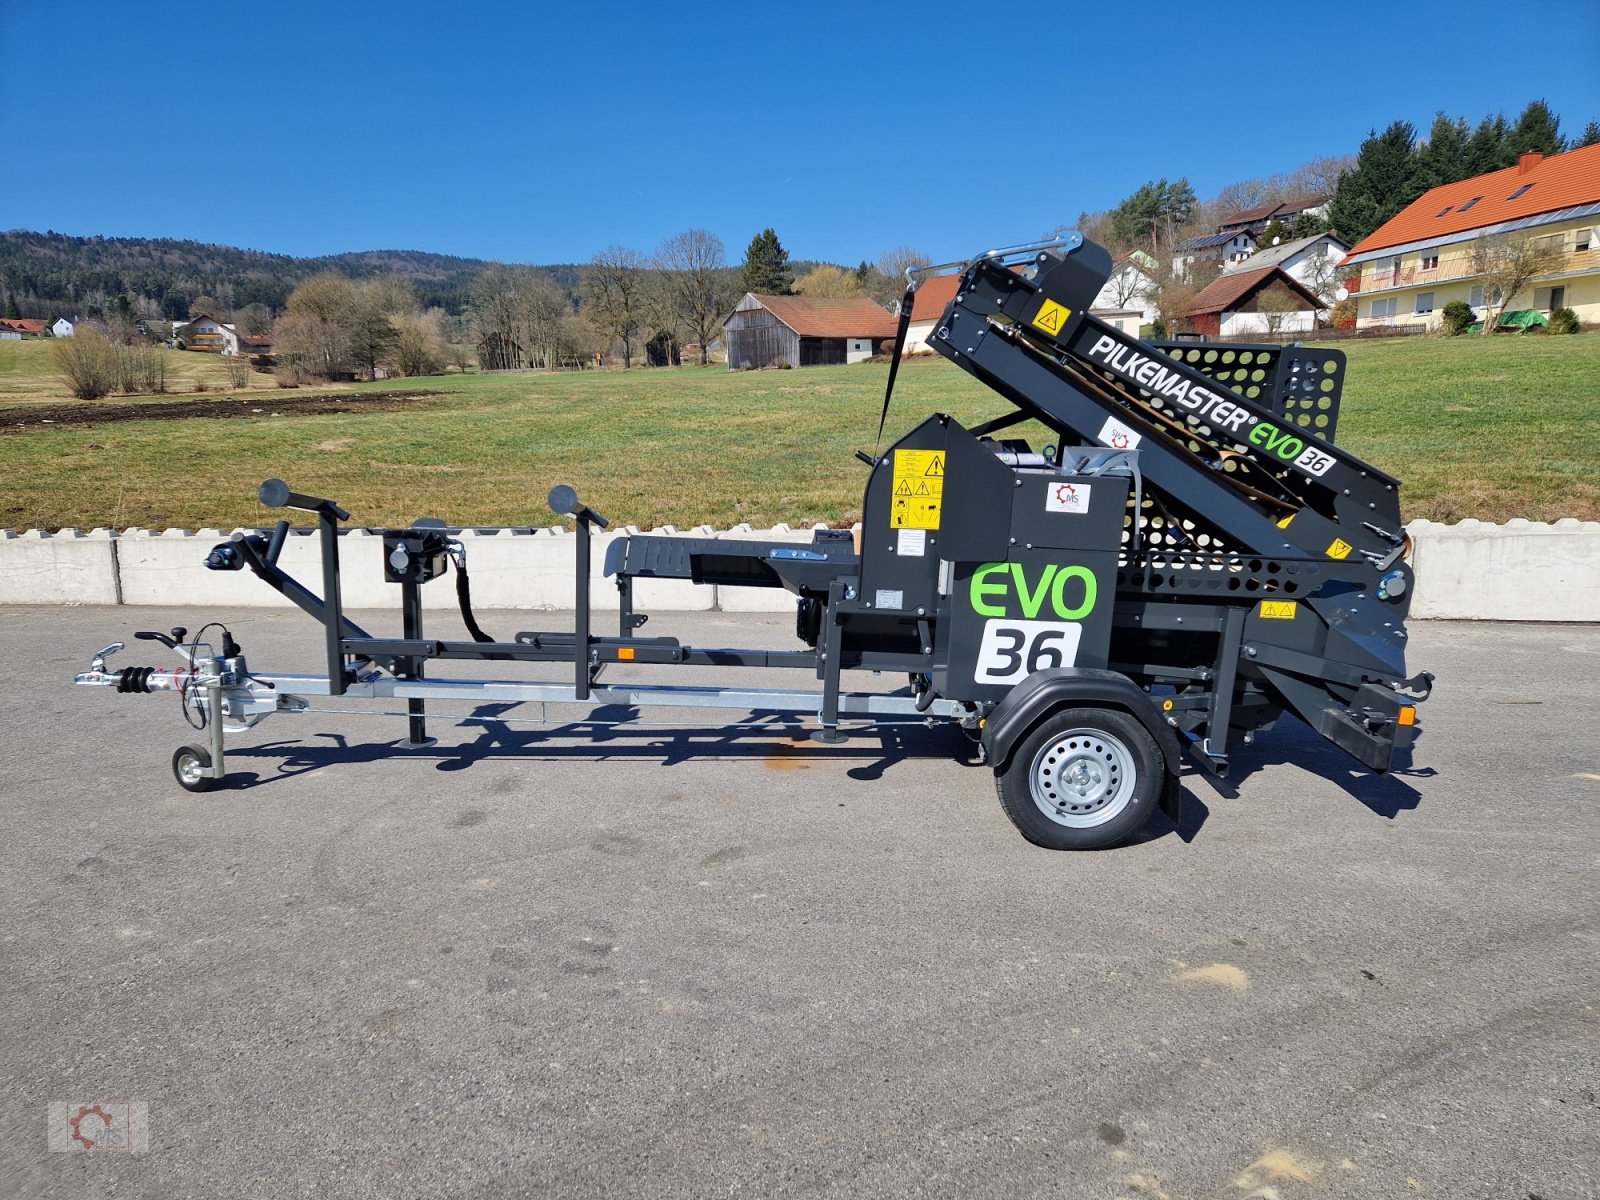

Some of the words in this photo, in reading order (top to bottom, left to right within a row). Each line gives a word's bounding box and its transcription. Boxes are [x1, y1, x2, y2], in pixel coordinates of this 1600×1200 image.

[1249, 422, 1303, 460] EVO
[1297, 449, 1328, 472] 36
[1066, 494, 1079, 503] MS
[970, 562, 1098, 620] EVO
[985, 628, 1066, 677] 36
